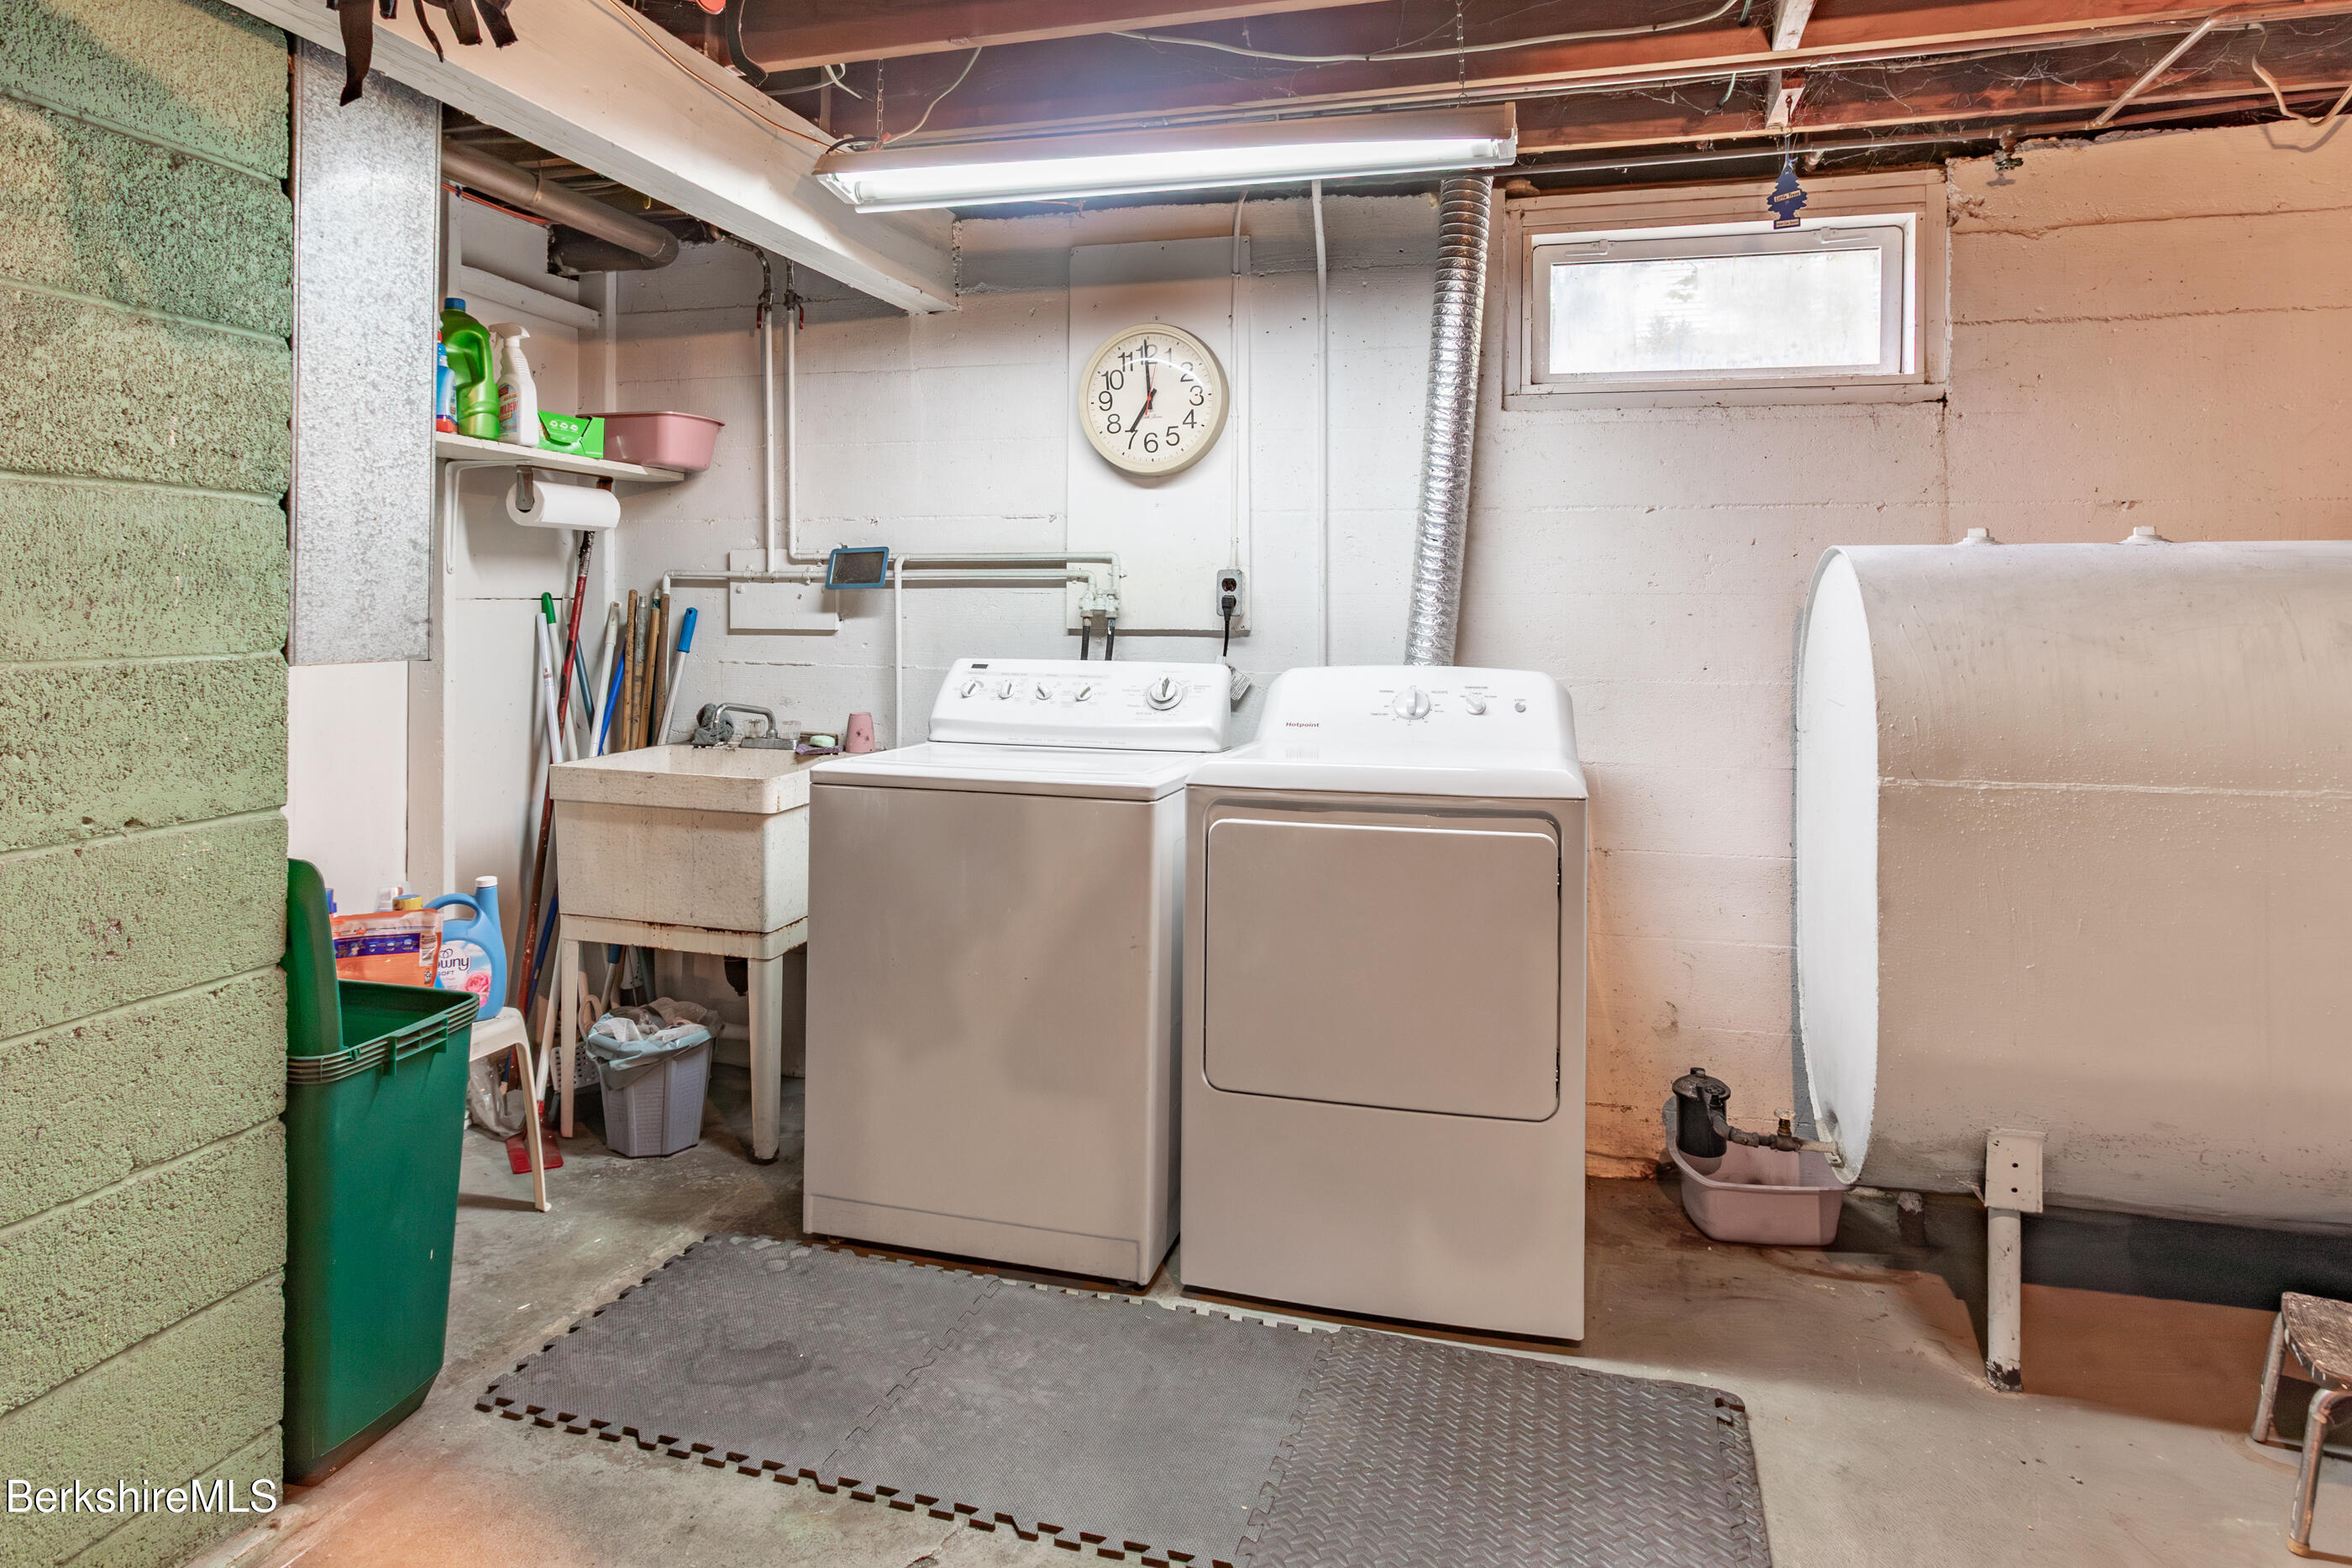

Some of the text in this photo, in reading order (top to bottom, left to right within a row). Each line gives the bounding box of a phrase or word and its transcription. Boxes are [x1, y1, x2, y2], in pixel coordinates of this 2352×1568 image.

[1118, 352, 1133, 372] 11
[1136, 343, 1158, 365] 12
[1164, 348, 1172, 367] 1
[1101, 370, 1124, 390] 10
[1180, 361, 1194, 382] 2
[1099, 391, 1113, 411] 9
[1189, 385, 1204, 406] 3
[1107, 413, 1121, 433] 8
[1183, 409, 1197, 428] 4
[1125, 429, 1138, 449] 7
[1144, 433, 1158, 453] 6
[1166, 426, 1180, 446] 5
[438, 957, 469, 971] wny
